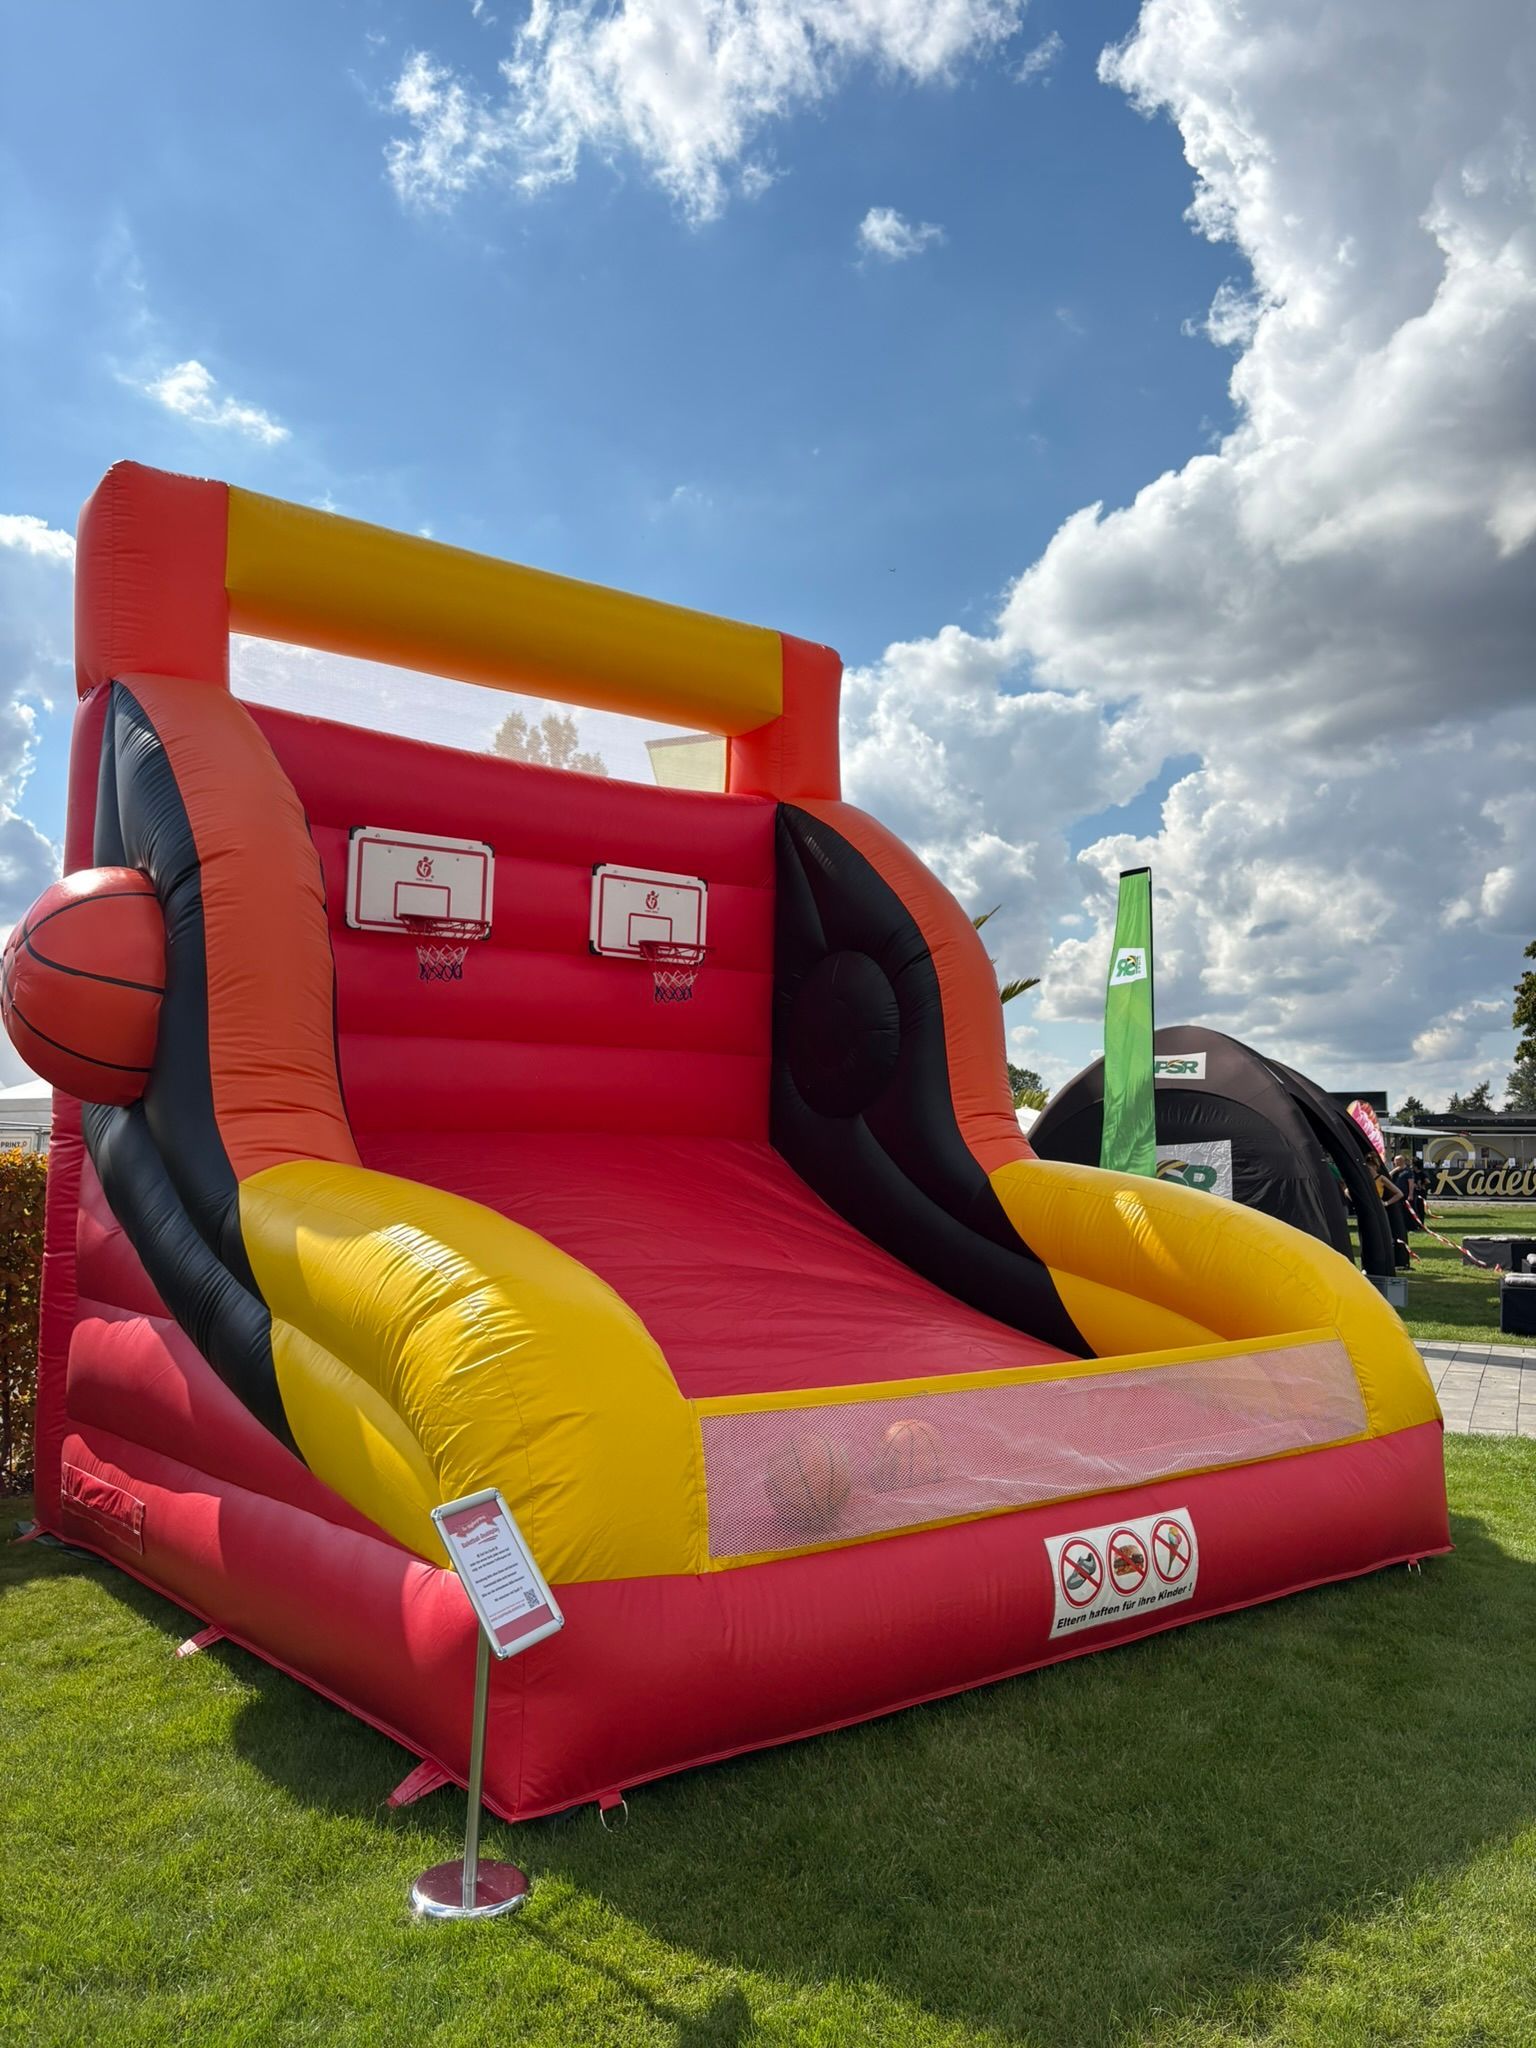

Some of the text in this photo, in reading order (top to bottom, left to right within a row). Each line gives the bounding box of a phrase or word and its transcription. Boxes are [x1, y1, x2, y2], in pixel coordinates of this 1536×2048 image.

[1154, 1058, 1199, 1074] PSR
[1056, 1582, 1193, 1629] Eltern haften für ihre Kinder !
